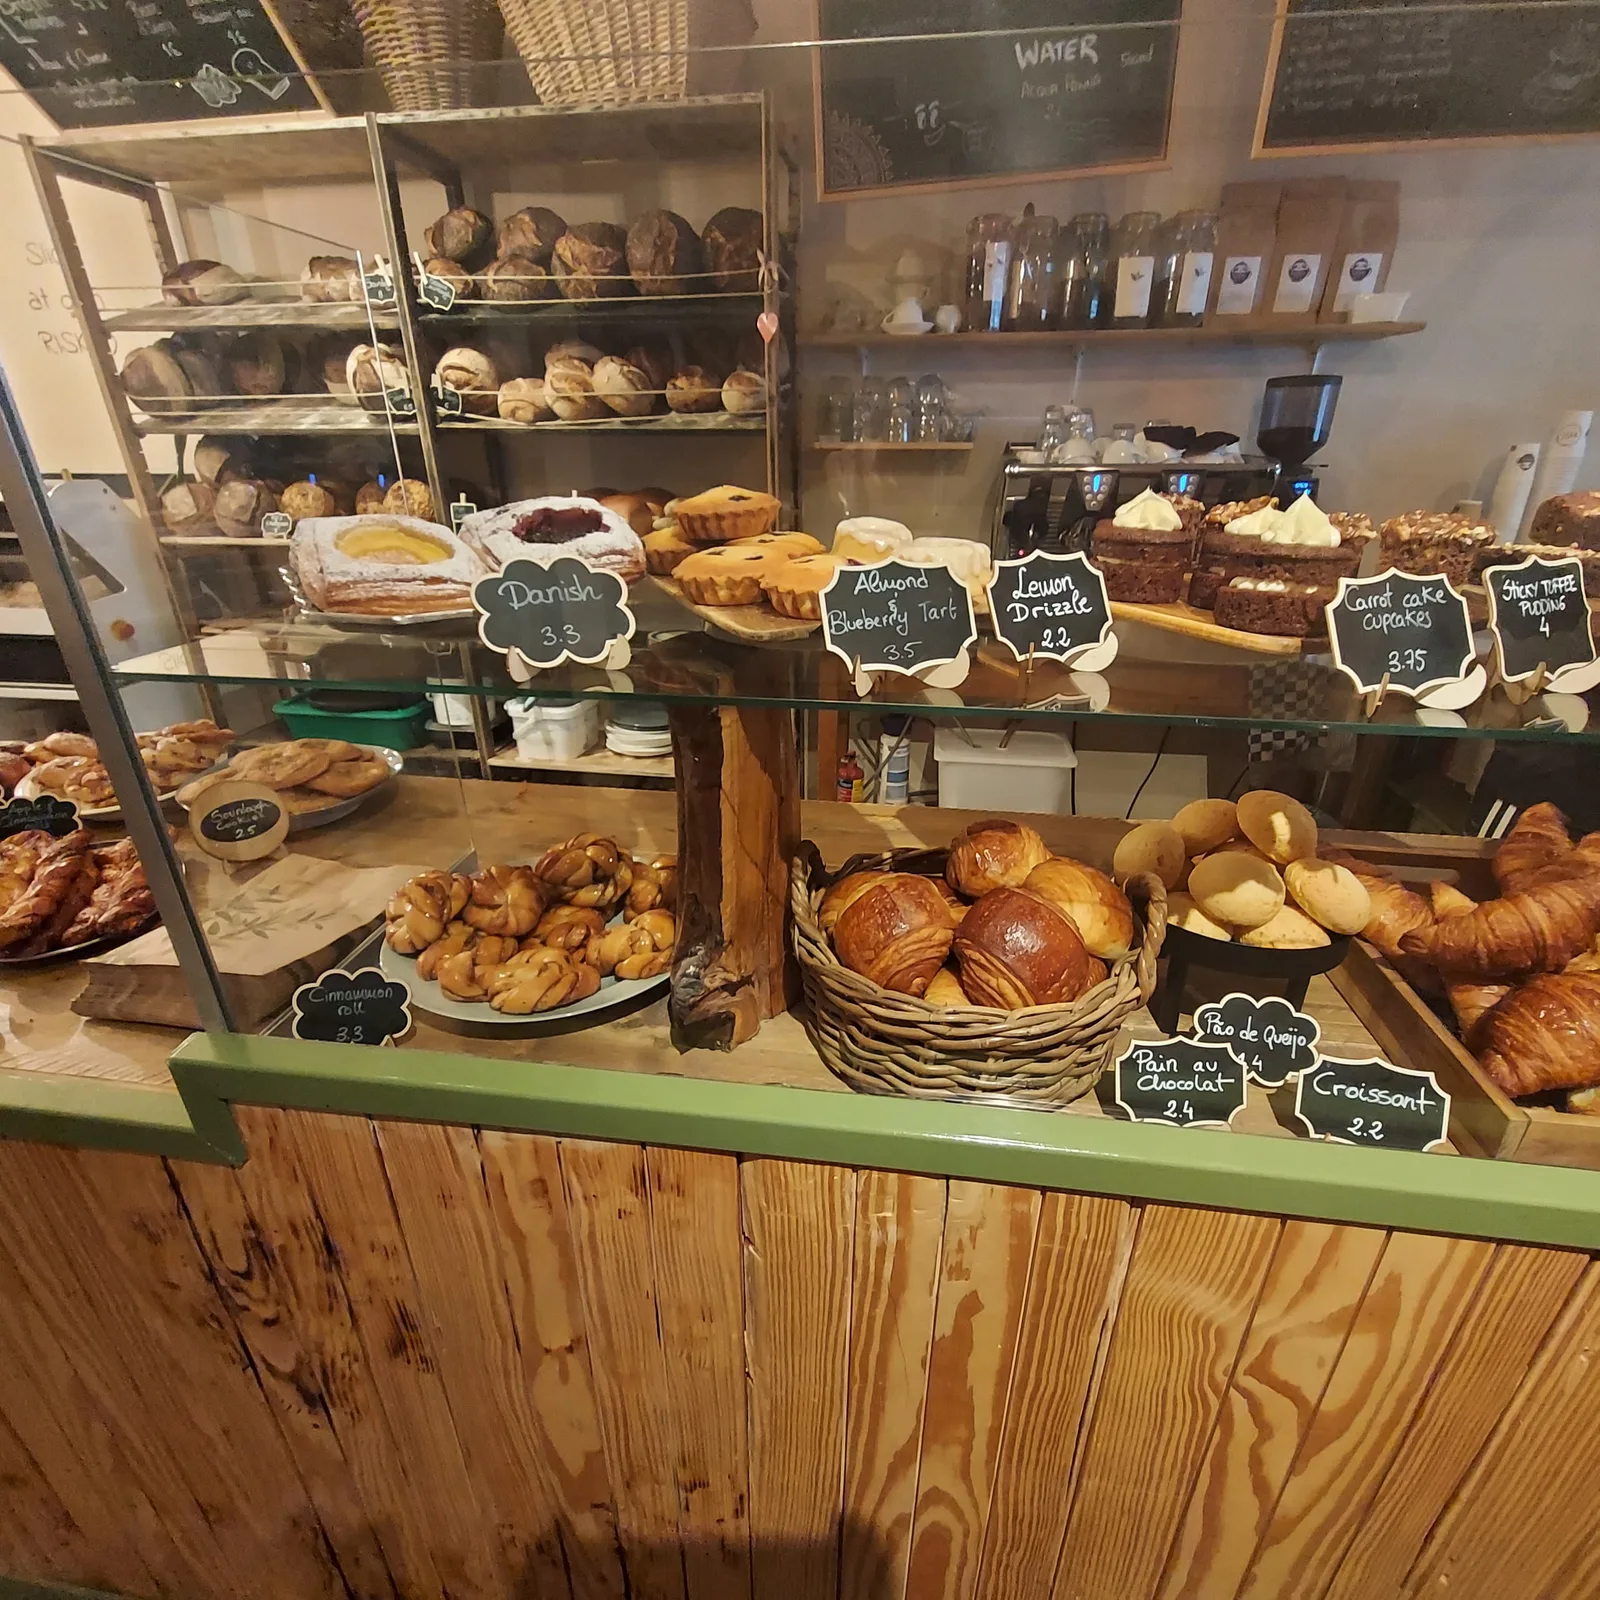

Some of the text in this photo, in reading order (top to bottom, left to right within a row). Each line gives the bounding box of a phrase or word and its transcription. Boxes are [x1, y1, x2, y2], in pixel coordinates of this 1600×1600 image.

[1014, 33, 1099, 72] WATER
[28, 287, 50, 310] at
[497, 573, 603, 610] Danish
[853, 568, 929, 596] Almond
[1012, 566, 1075, 599] Lemon
[1006, 589, 1093, 622] Drizzle
[1344, 582, 1394, 611] Carrot
[827, 598, 957, 636] Blueberry Tart
[1539, 616, 1550, 638] 4
[540, 624, 581, 646] 3.3
[1041, 626, 1071, 648] 2.2
[883, 641, 923, 661] 3.5
[1388, 649, 1428, 672] 3.75
[338, 1001, 367, 1016] roll
[336, 1025, 364, 1042] 3.3
[1203, 1011, 1307, 1059] Pão de Queijo
[1132, 1049, 1218, 1074] Pain au
[1136, 1071, 1235, 1093] Chocolat
[1312, 1071, 1437, 1115] Croissant
[1163, 1099, 1194, 1120] 2.4
[1346, 1117, 1385, 1140] 2.2
